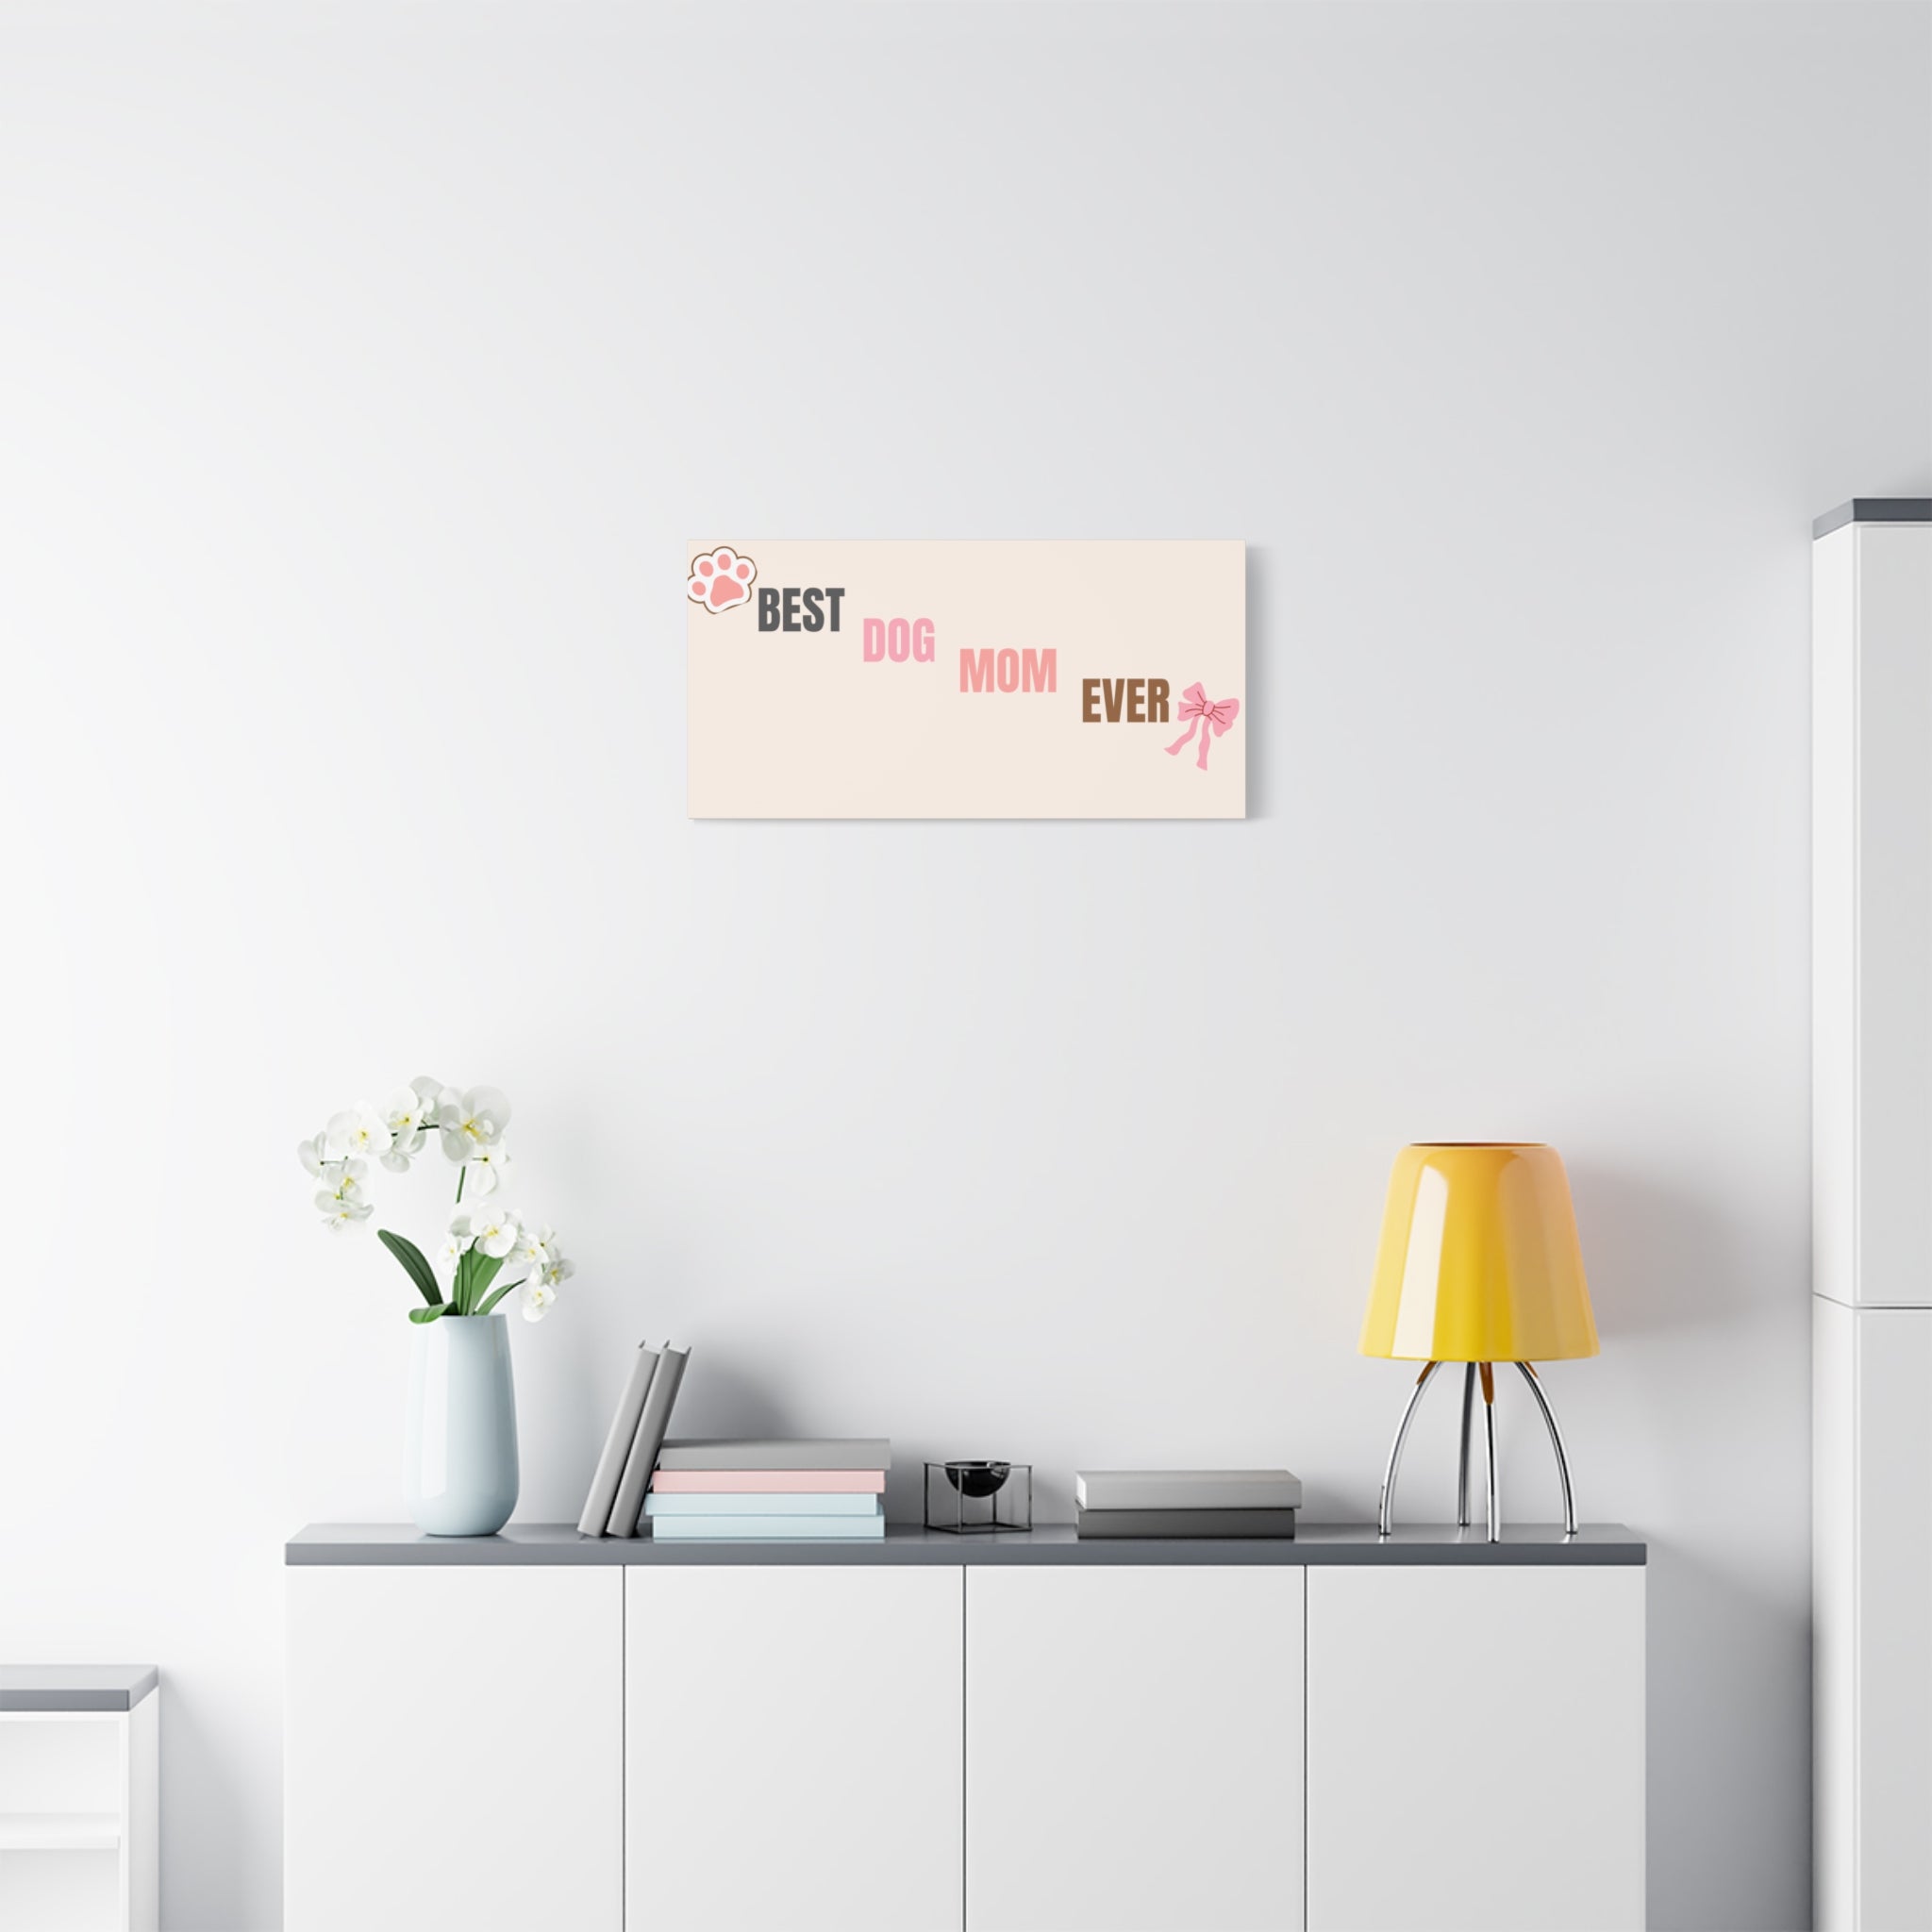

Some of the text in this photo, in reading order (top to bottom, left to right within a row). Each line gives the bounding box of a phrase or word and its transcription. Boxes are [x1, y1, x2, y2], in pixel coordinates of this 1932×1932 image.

[758, 587, 846, 633] BEST
[863, 617, 936, 663] DOG
[959, 648, 1058, 693] MOM
[1081, 677, 1171, 724] EVER
